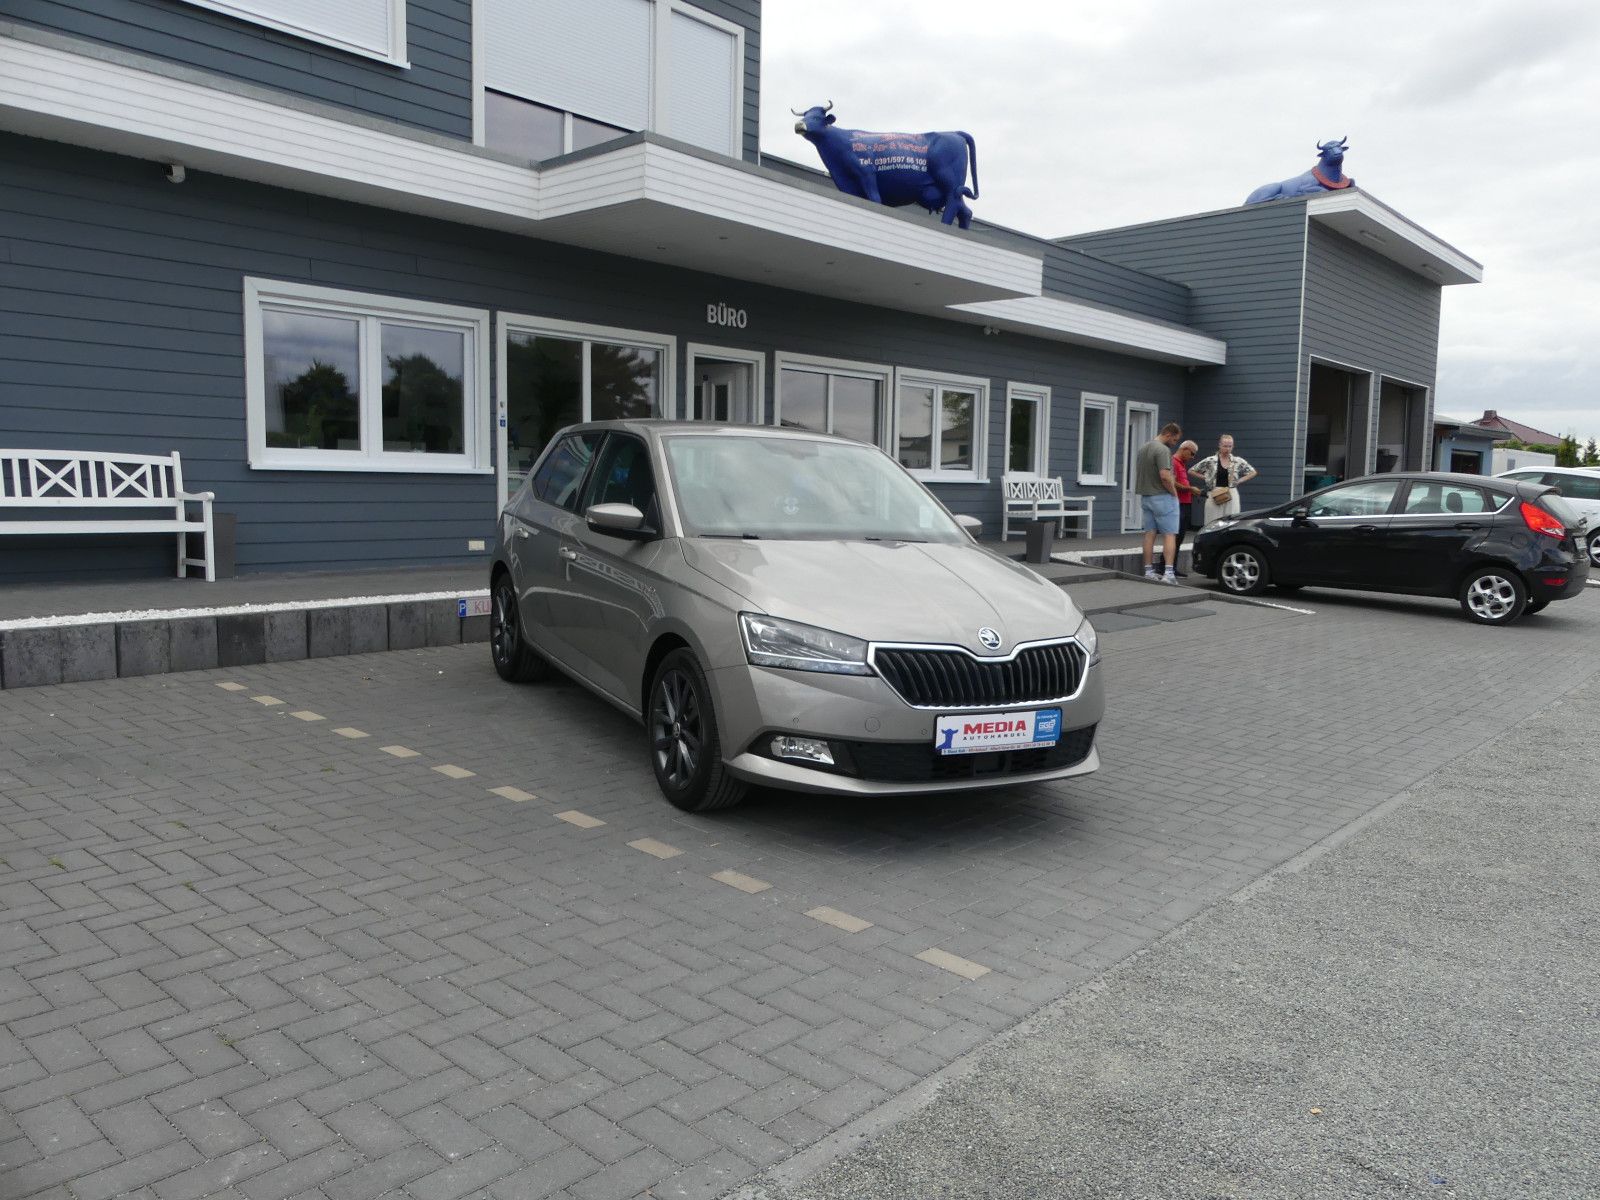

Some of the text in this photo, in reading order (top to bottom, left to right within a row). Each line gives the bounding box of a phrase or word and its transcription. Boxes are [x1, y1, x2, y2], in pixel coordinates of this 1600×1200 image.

[859, 158, 873, 166] Tel.
[915, 158, 927, 167] 100
[707, 302, 747, 329] BÜRO
[963, 720, 1027, 735] MEDIA
[962, 732, 1027, 741] AUTOHANDEL
